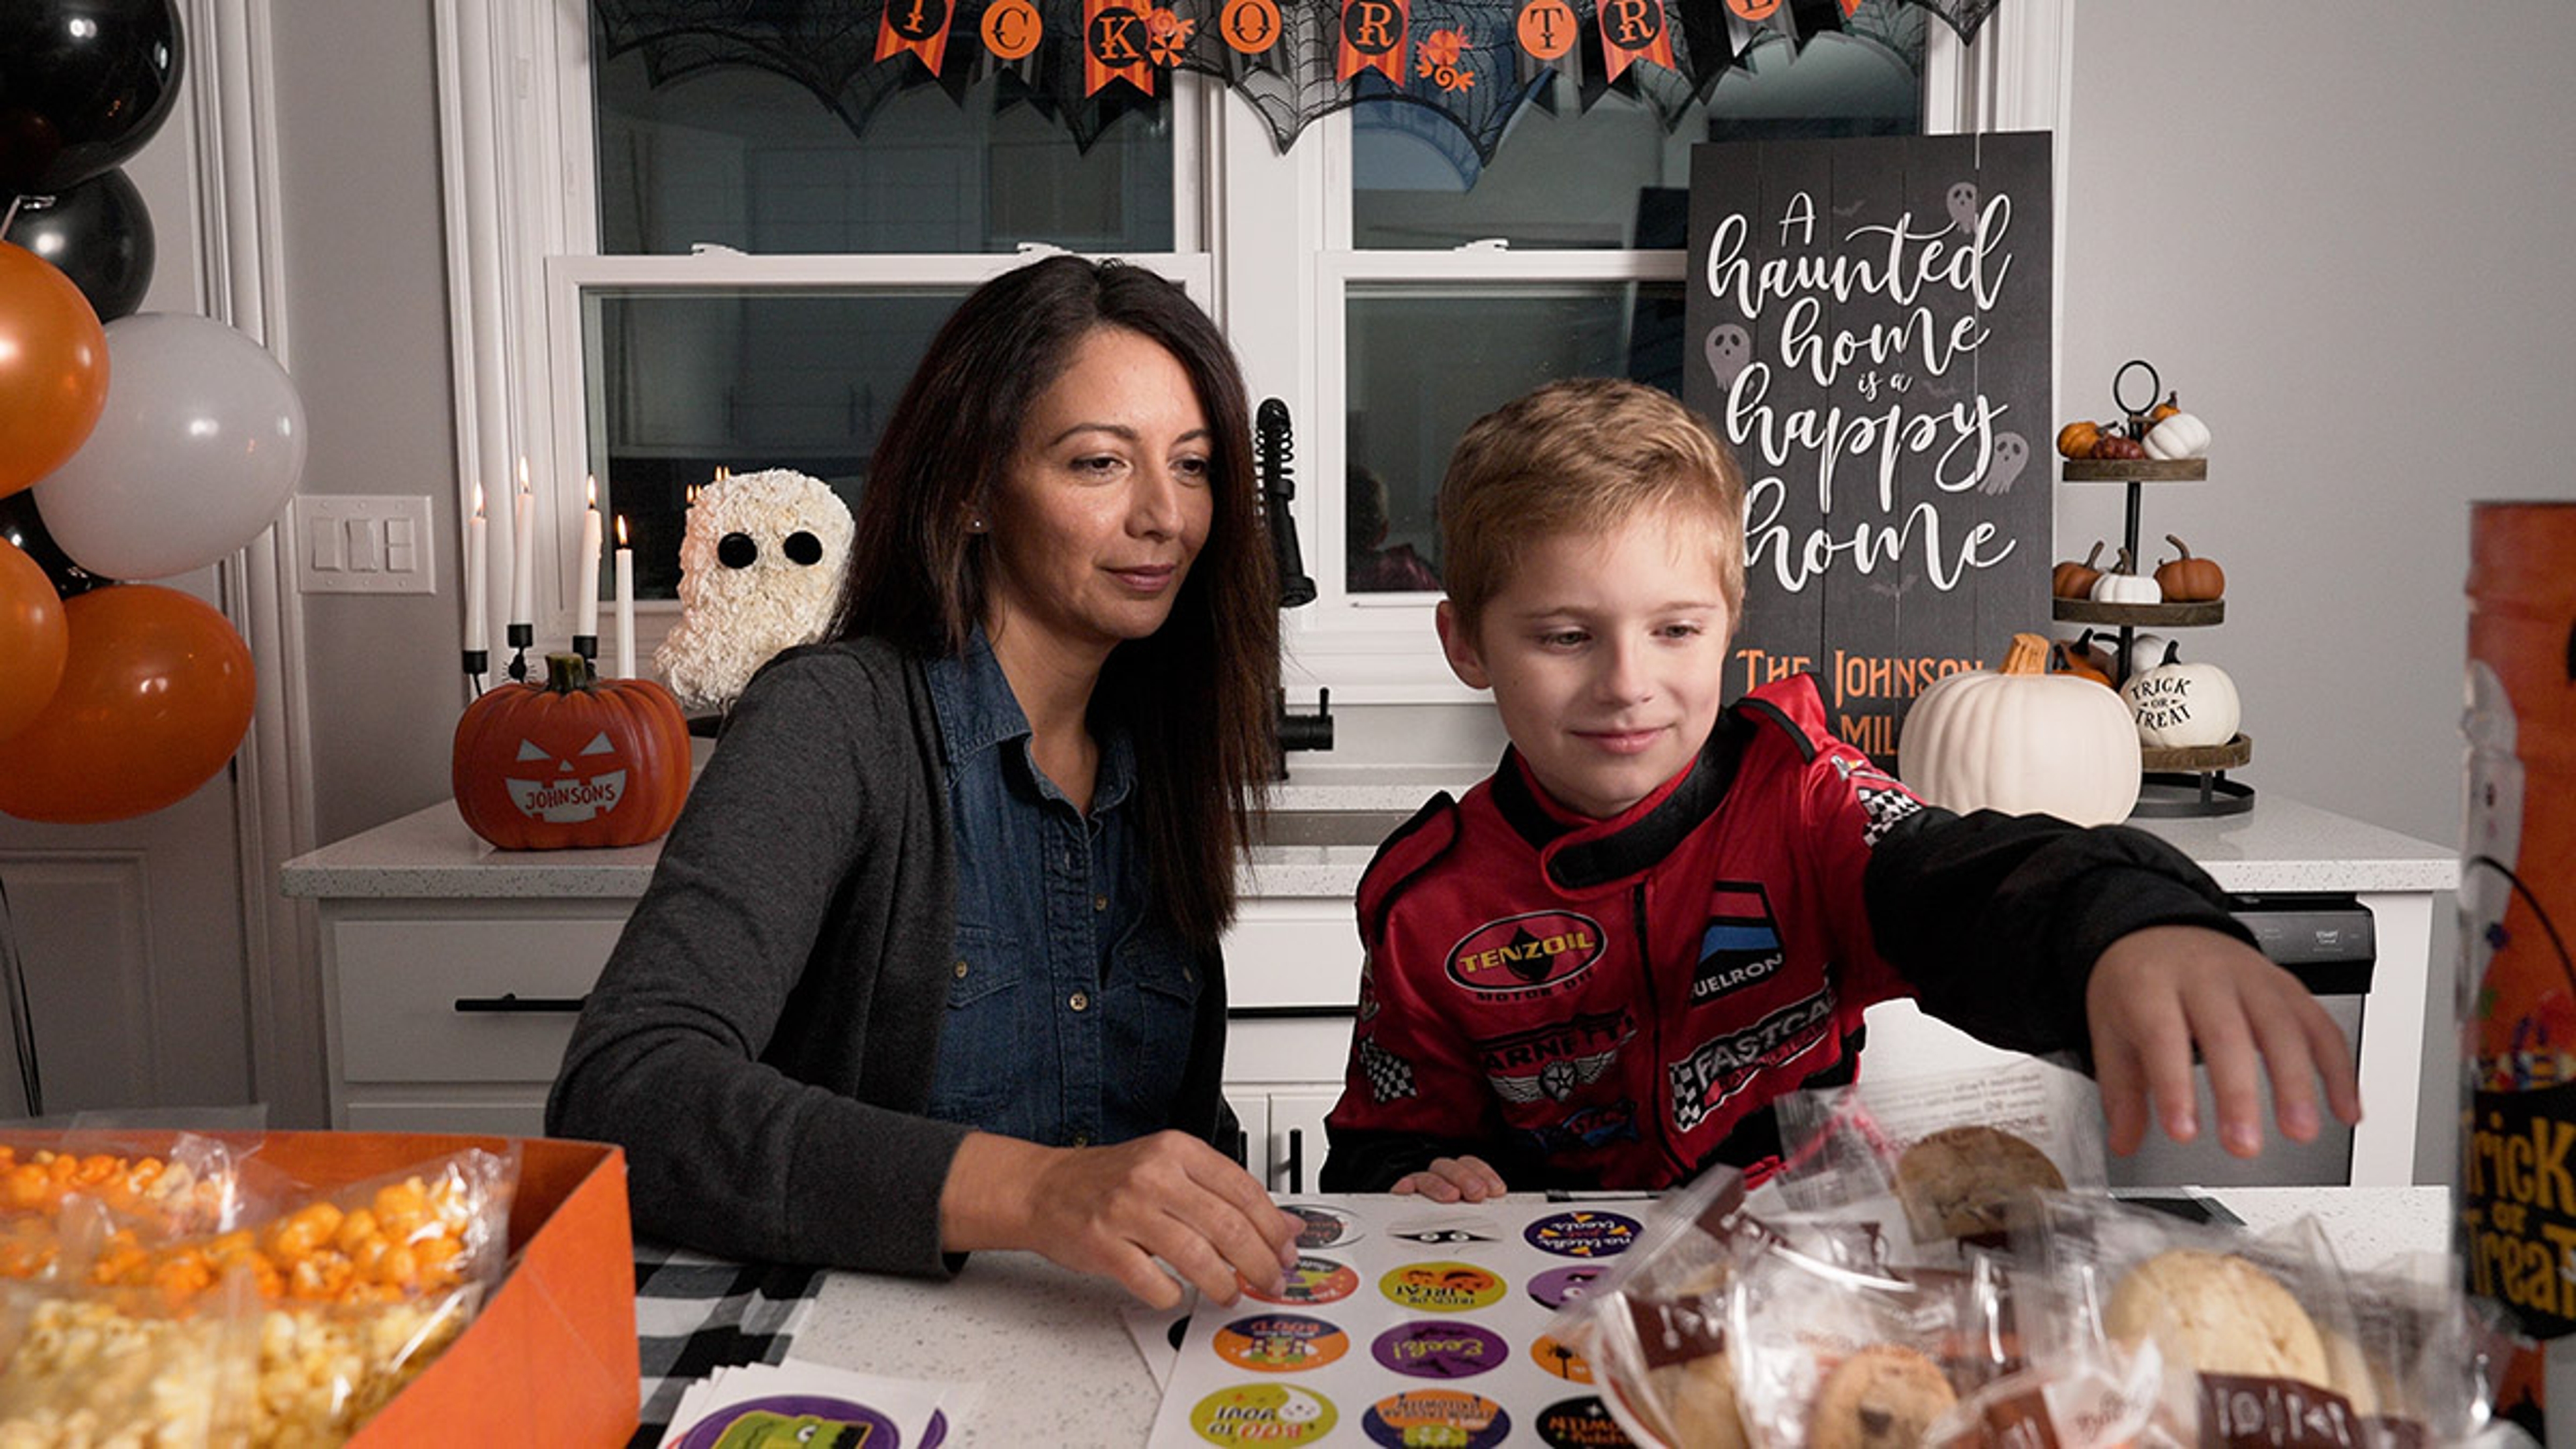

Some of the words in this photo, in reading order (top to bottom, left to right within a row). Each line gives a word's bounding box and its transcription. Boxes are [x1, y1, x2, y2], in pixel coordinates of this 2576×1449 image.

[1780, 192, 1816, 247] A
[1708, 194, 2012, 319] haunted
[1781, 297, 1990, 386] home
[1858, 371, 1883, 402] is
[1890, 373, 1913, 393] a
[1727, 363, 2008, 514] happy
[1743, 477, 2016, 592] home
[2131, 678, 2192, 700] TRICK
[2151, 698, 2168, 708] OR
[2135, 704, 2191, 731] TREAT
[526, 784, 616, 809] JOHNSONS
[1460, 932, 1595, 973] TENZOIL
[1692, 953, 1783, 998] UELRON
[1696, 989, 1837, 1092] FASTCA
